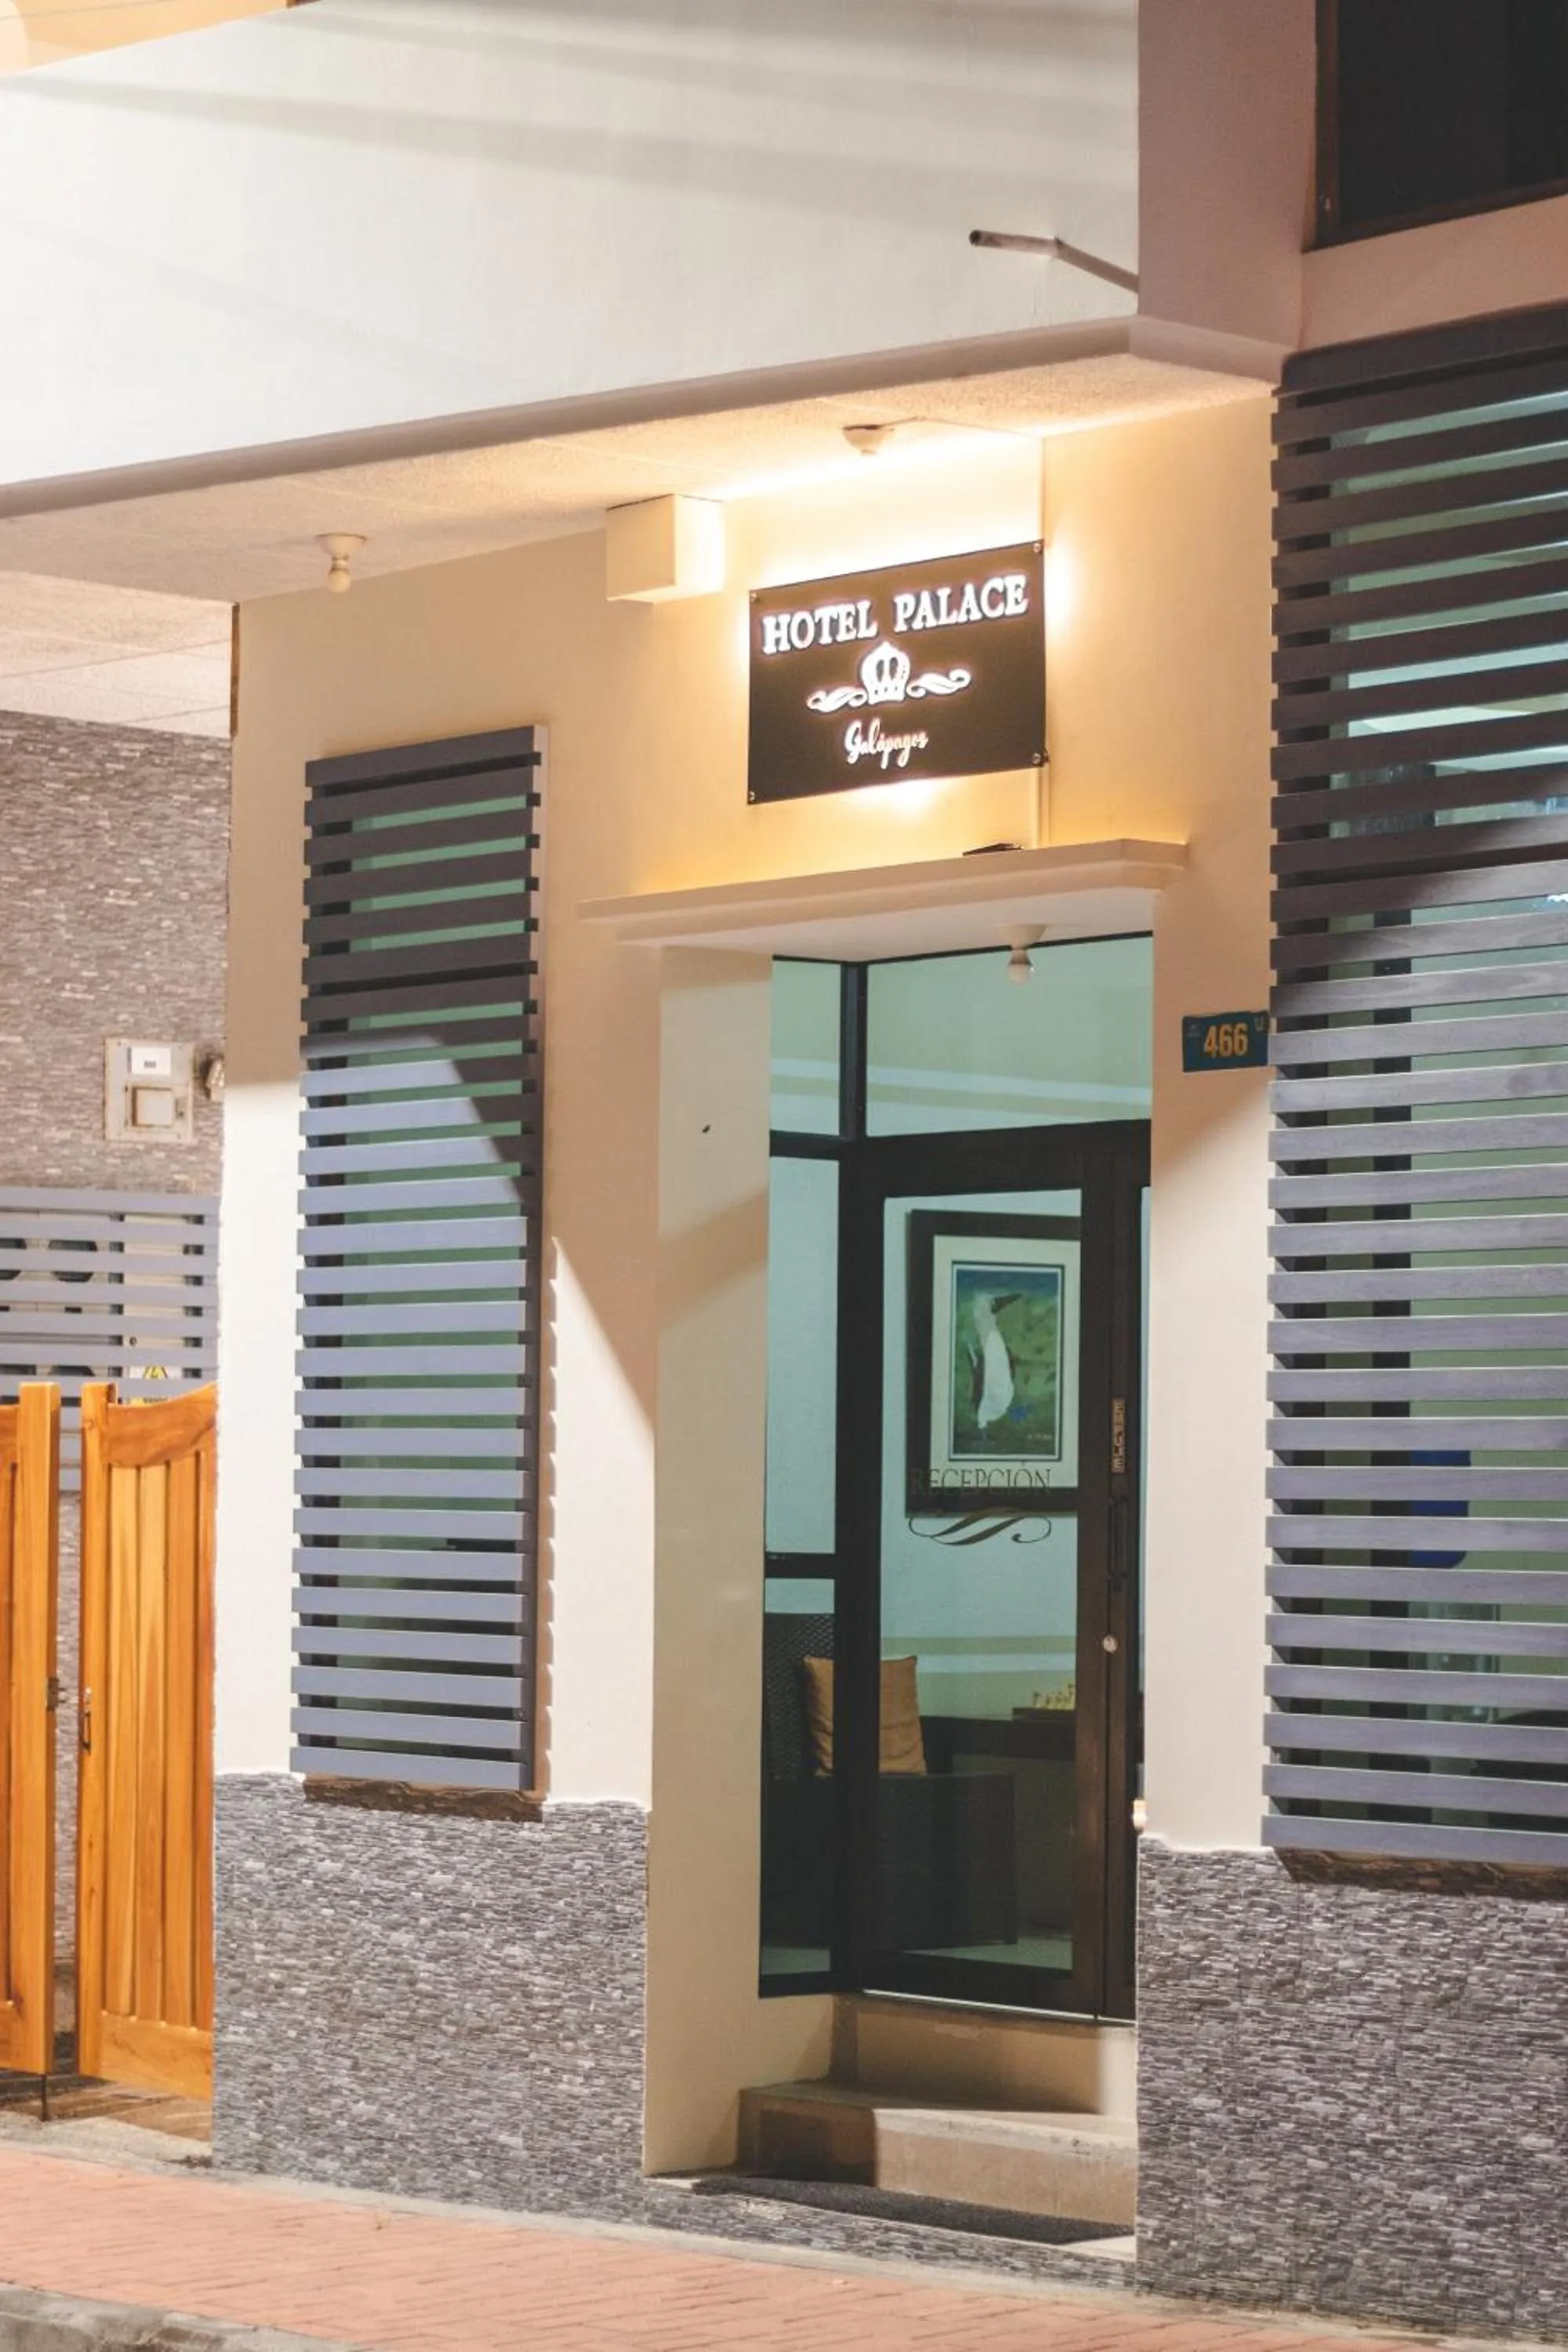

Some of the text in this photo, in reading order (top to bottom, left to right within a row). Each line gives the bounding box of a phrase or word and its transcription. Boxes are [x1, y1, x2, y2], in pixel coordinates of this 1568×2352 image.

[762, 574, 1029, 654] HOTEL PALACE
[1204, 1022, 1248, 1058] 466
